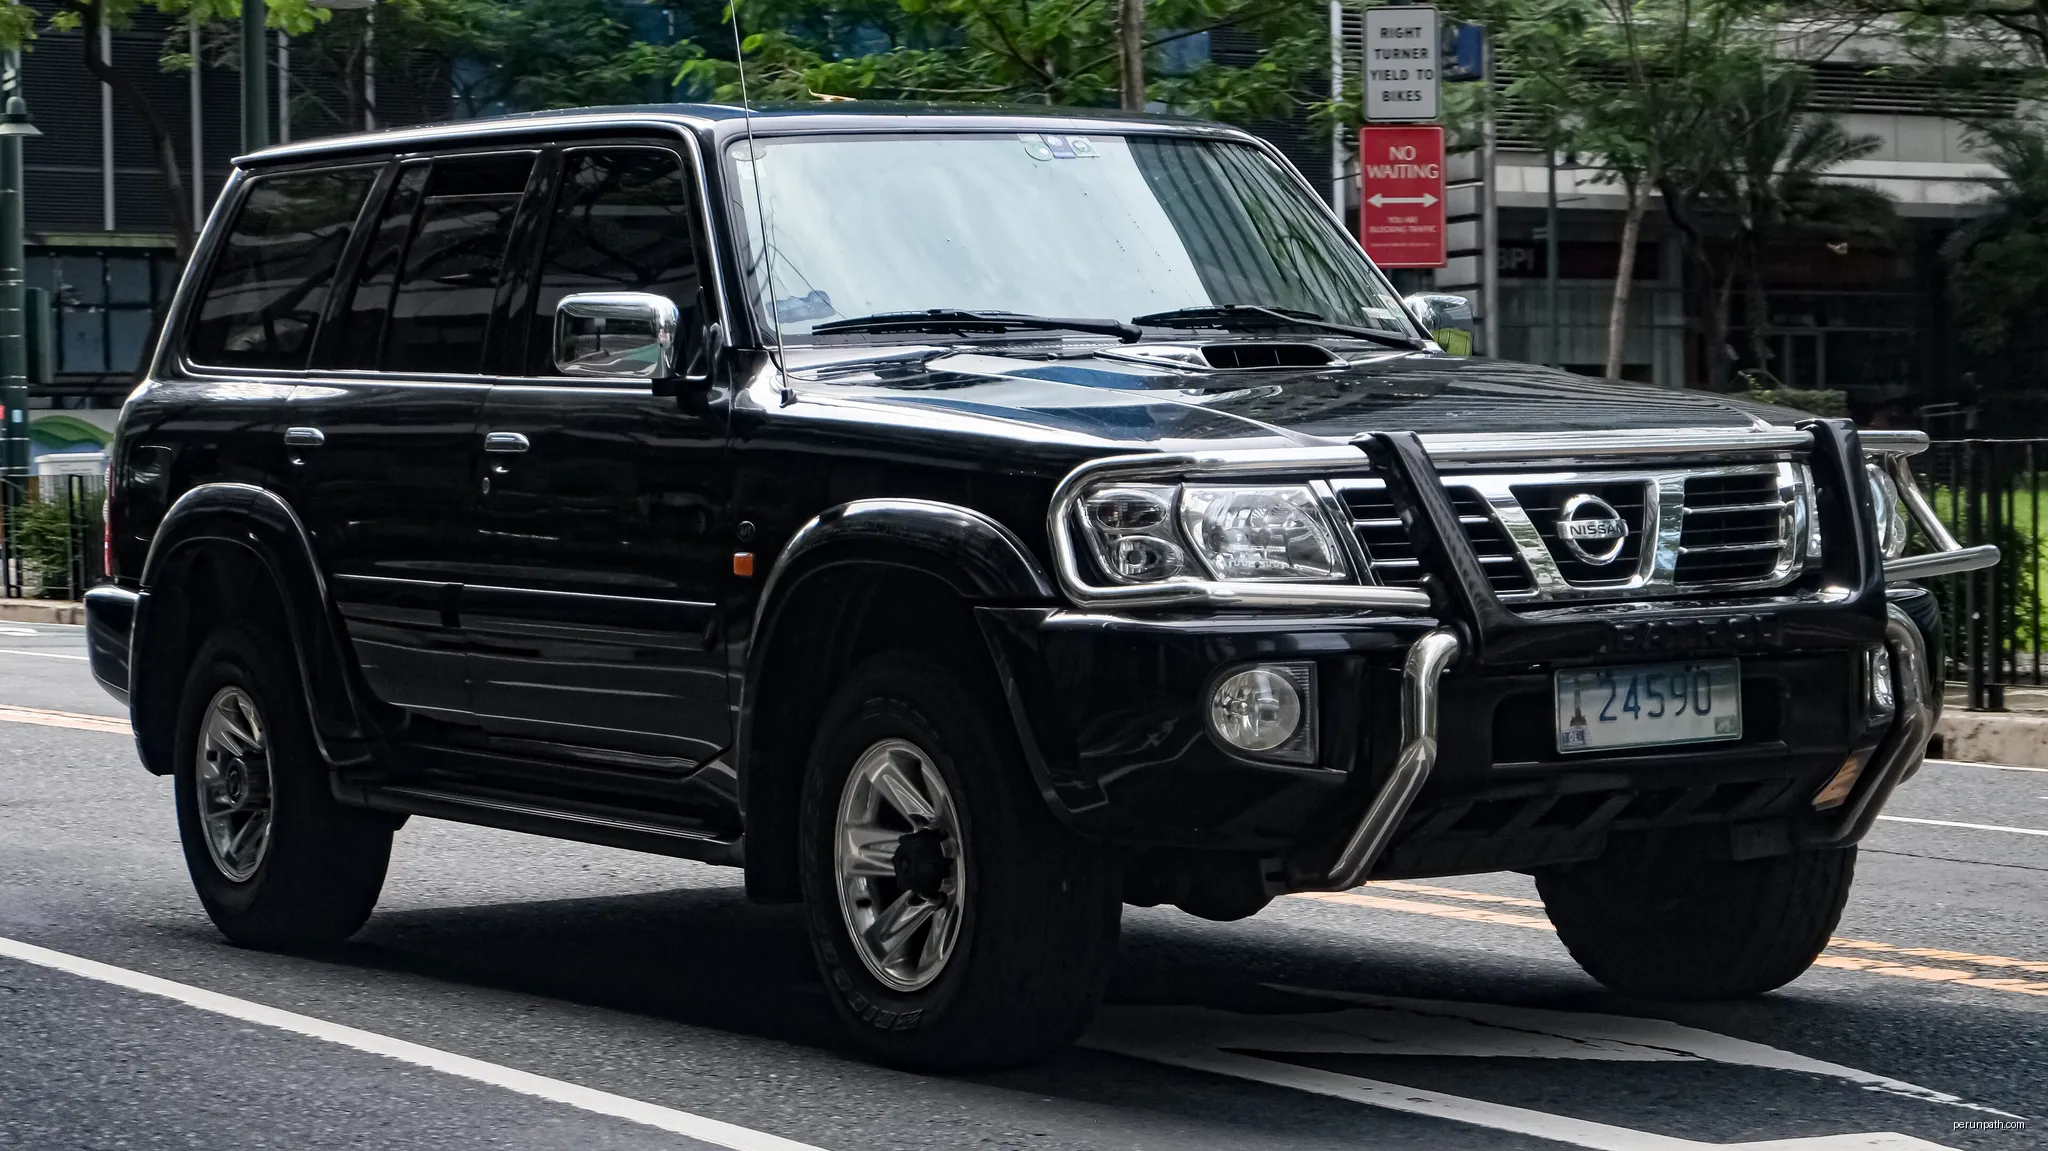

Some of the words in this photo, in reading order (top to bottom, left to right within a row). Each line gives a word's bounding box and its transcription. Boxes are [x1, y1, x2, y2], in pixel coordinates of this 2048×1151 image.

[1380, 27, 1422, 39] RIGHT
[1374, 48, 1429, 60] TURNER
[1369, 69, 1409, 81] YIELD
[1417, 69, 1434, 80] TO
[1382, 90, 1422, 102] BIKES
[1388, 145, 1417, 161] NO
[1366, 163, 1440, 179] WAITING
[1570, 523, 1622, 536] NISSAN
[1599, 670, 1711, 721] 24590
